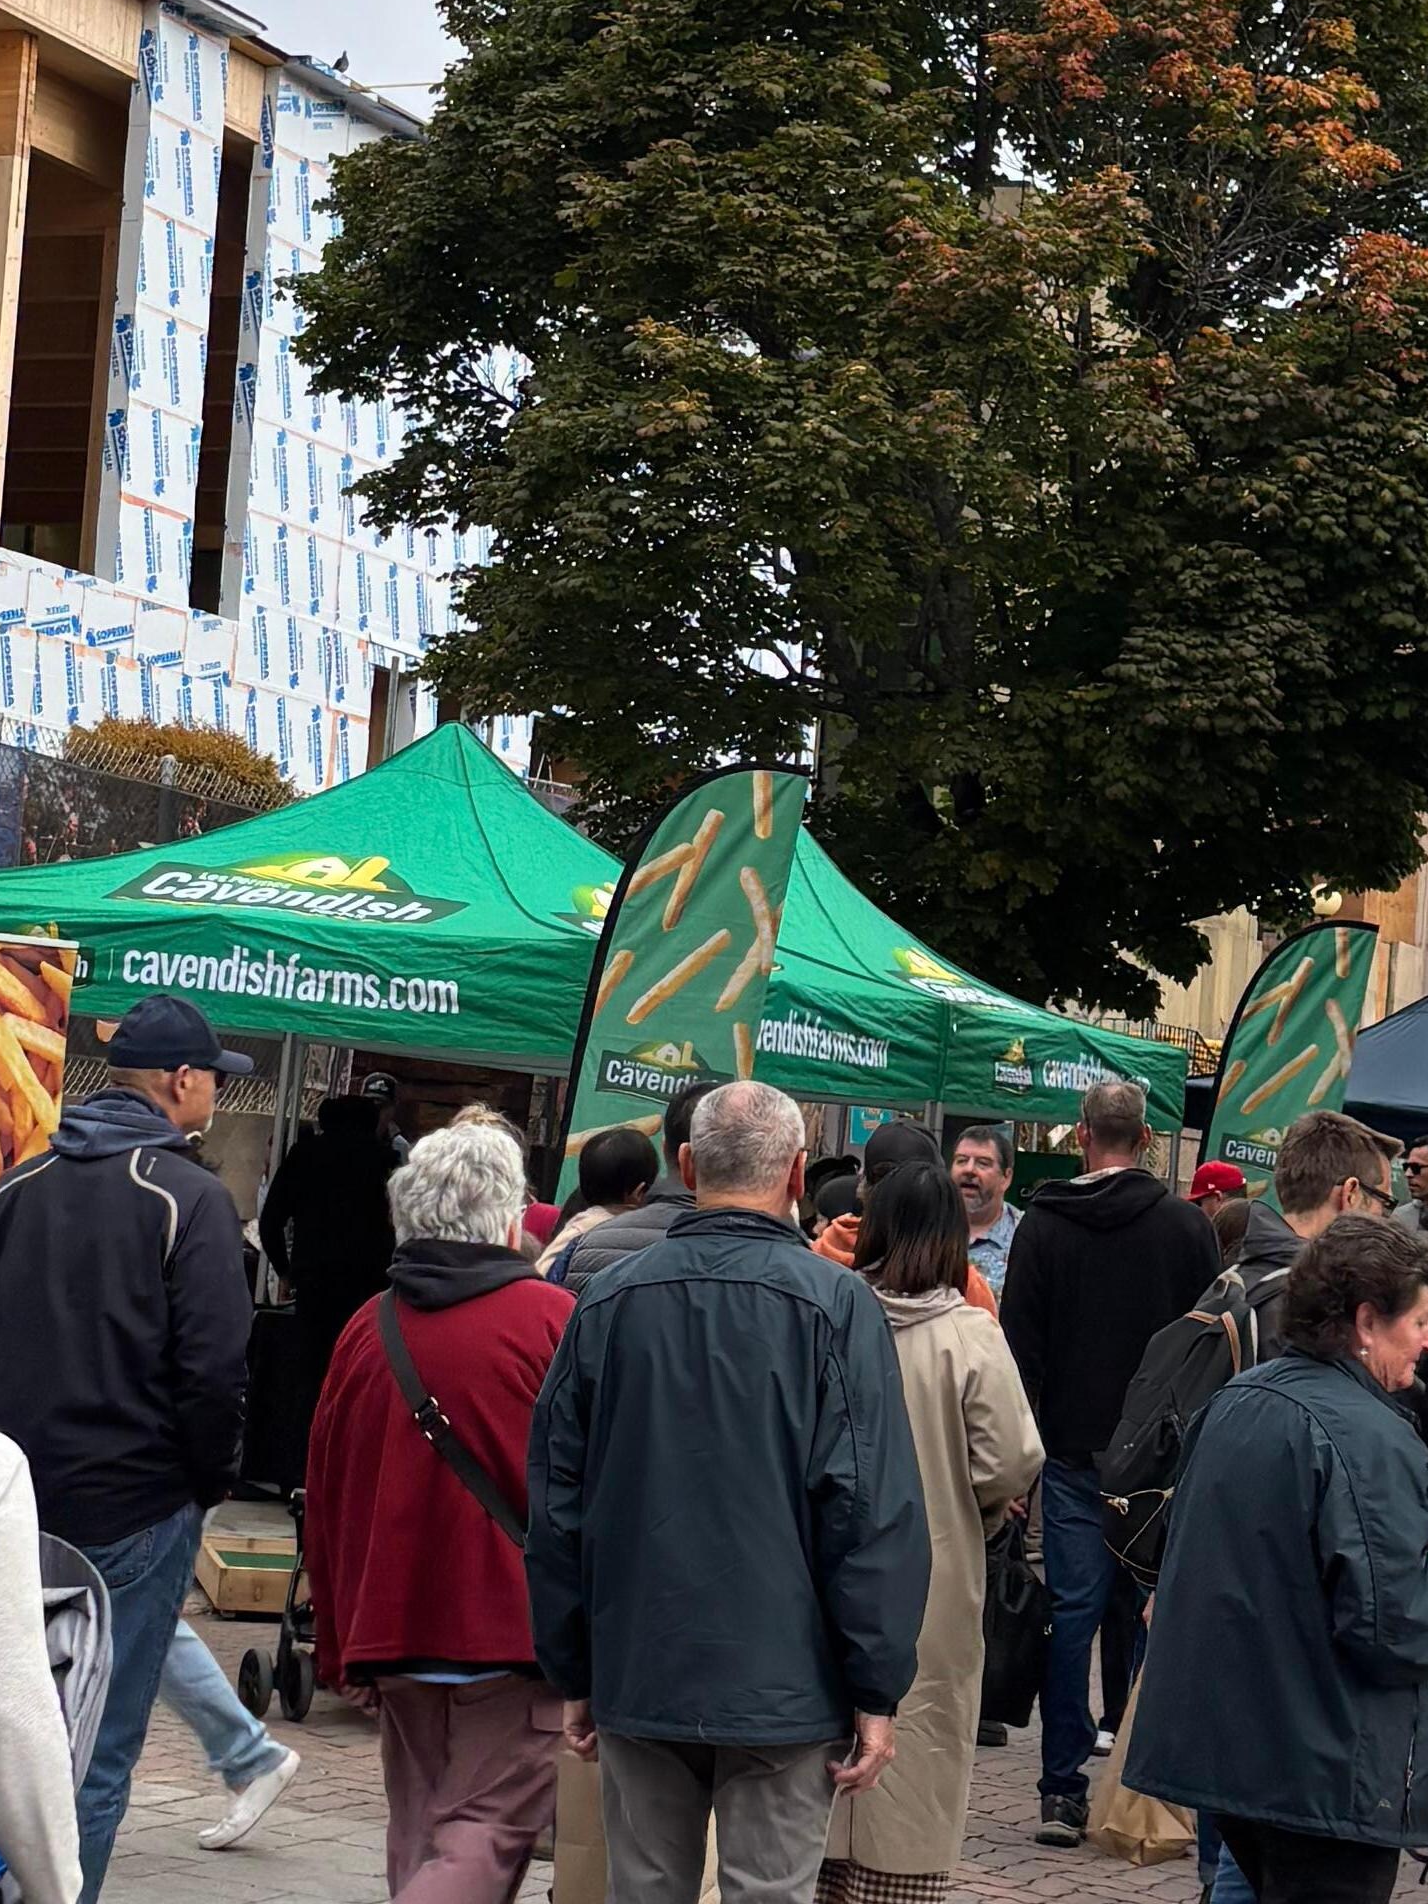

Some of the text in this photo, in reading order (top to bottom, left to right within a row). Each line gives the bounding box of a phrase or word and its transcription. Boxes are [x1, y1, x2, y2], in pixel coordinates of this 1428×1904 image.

[192, 52, 202, 121] SOPREMA
[3, 636, 14, 707] SOPREMA
[141, 871, 433, 922] Cavendish
[123, 945, 459, 1014] cavendishfarms.com
